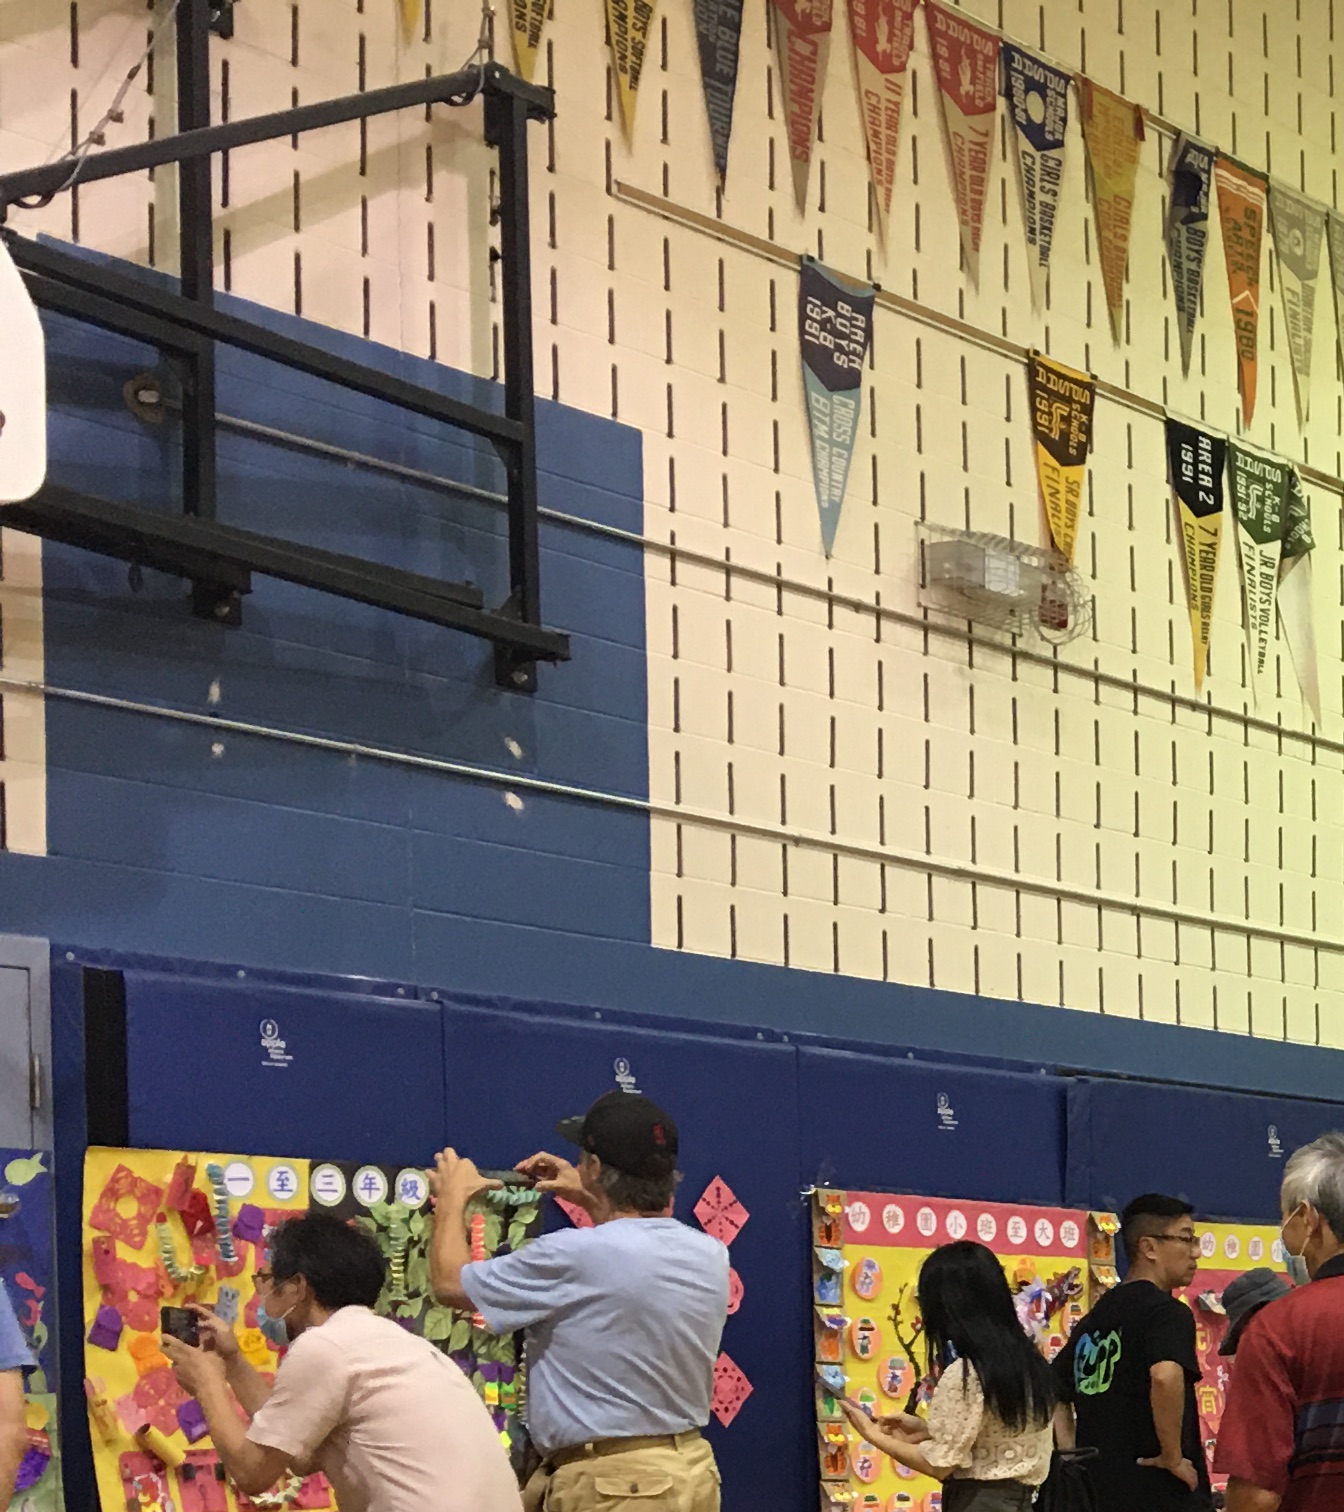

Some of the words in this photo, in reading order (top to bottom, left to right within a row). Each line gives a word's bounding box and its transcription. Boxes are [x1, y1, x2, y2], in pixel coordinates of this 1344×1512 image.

[716, 25, 738, 78] BLUE
[935, 37, 952, 82] 1981
[786, 28, 818, 163] CHAMPIONS
[983, 62, 994, 105] TRACK
[864, 88, 884, 186] CHAMPIONS
[884, 98, 900, 131] YEAR
[968, 125, 989, 137] 7
[1044, 89, 1057, 141] SCHOOLS
[1053, 93, 1066, 141] MAJOR
[884, 132, 898, 159] OLD
[966, 139, 988, 173] YEAR
[951, 130, 970, 226] CHAMPIONS
[967, 173, 985, 198] OLD
[1021, 150, 1037, 246] CHAMPIONS
[1038, 200, 1057, 269] BASKETBALL
[1113, 194, 1131, 241] GIRLS
[804, 297, 821, 346] 1991
[1185, 267, 1200, 334] BASKETBALL
[820, 306, 837, 349] K-8
[833, 300, 851, 369] BOYS
[849, 313, 866, 371] AREA
[1235, 307, 1255, 362] 1980
[1035, 366, 1090, 405] SPSAA
[831, 394, 856, 443] CROSS
[1035, 391, 1050, 433] 1991
[1068, 403, 1082, 456] SCHOOLS
[1080, 413, 1089, 443] K-8
[815, 441, 831, 508] CHAMPIONS
[830, 446, 849, 503] COUNTRY
[1181, 443, 1194, 484] 1991
[1198, 436, 1214, 488] AREA
[1064, 499, 1078, 532] BOYS
[1198, 490, 1215, 506] 2
[1235, 470, 1248, 522] 1991-92
[1262, 482, 1275, 535] SCHOOLS
[1272, 496, 1281, 524] K-8
[1198, 525, 1218, 538] 7
[1184, 521, 1199, 612] CHAMPIONS
[1198, 541, 1218, 574] YEAR
[1199, 573, 1216, 595] OLD
[1200, 595, 1213, 620] GIRLS
[1243, 541, 1258, 630] FINALISTS
[1257, 572, 1276, 607] BOYS
[1257, 607, 1271, 675] VOLLEYBALL
[227, 1170, 421, 1201] 一至三年級
